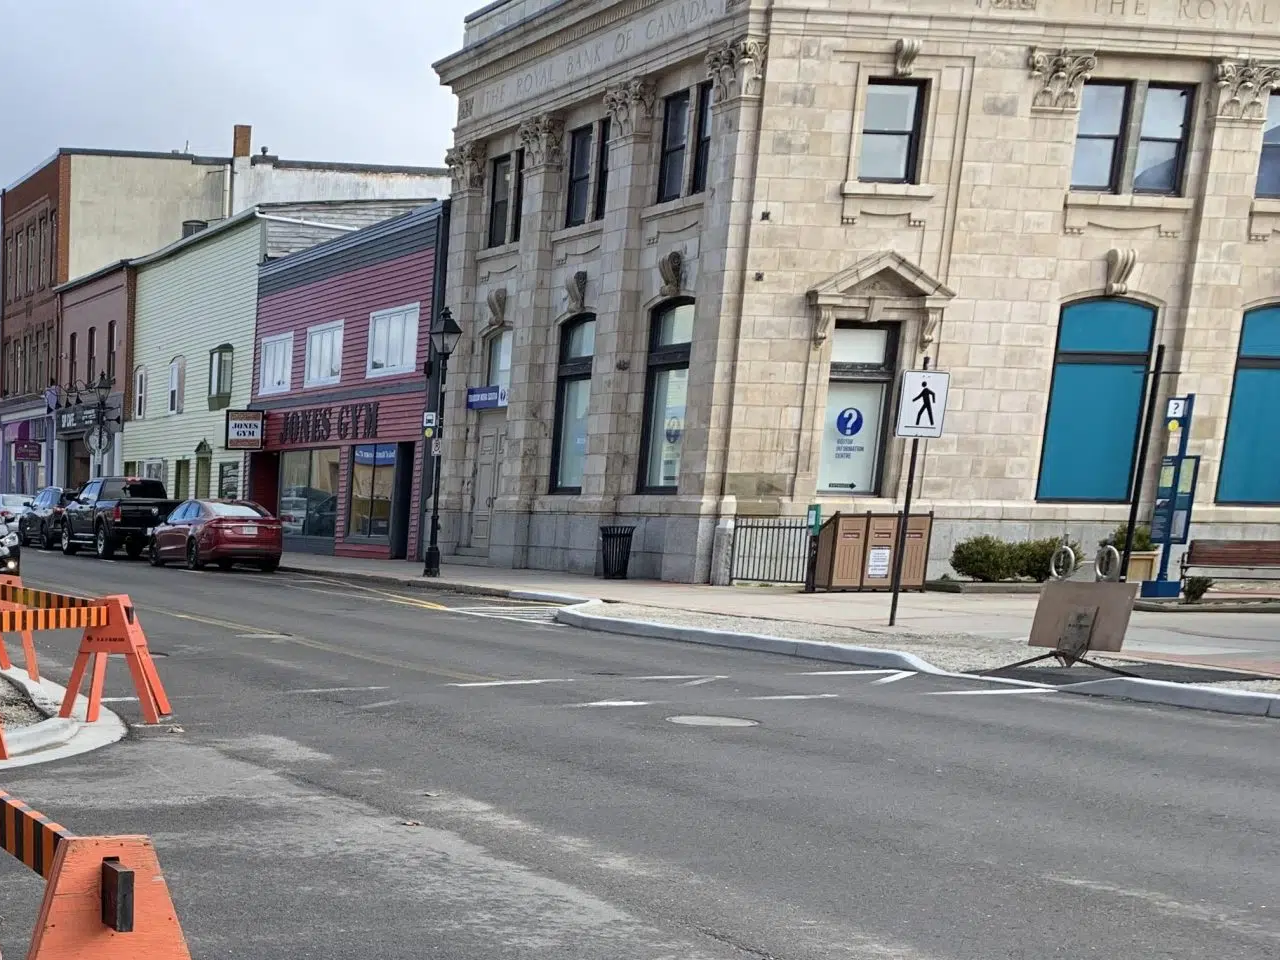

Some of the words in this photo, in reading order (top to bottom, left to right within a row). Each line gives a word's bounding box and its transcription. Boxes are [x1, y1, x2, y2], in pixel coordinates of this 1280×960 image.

[1177, 0, 1273, 24] ROYAL
[517, 64, 554, 96] ROYAL
[566, 42, 603, 75] BANK
[614, 28, 632, 53] OF
[231, 422, 258, 430] JONES
[279, 407, 332, 444] JONES
[337, 401, 380, 440] GYM
